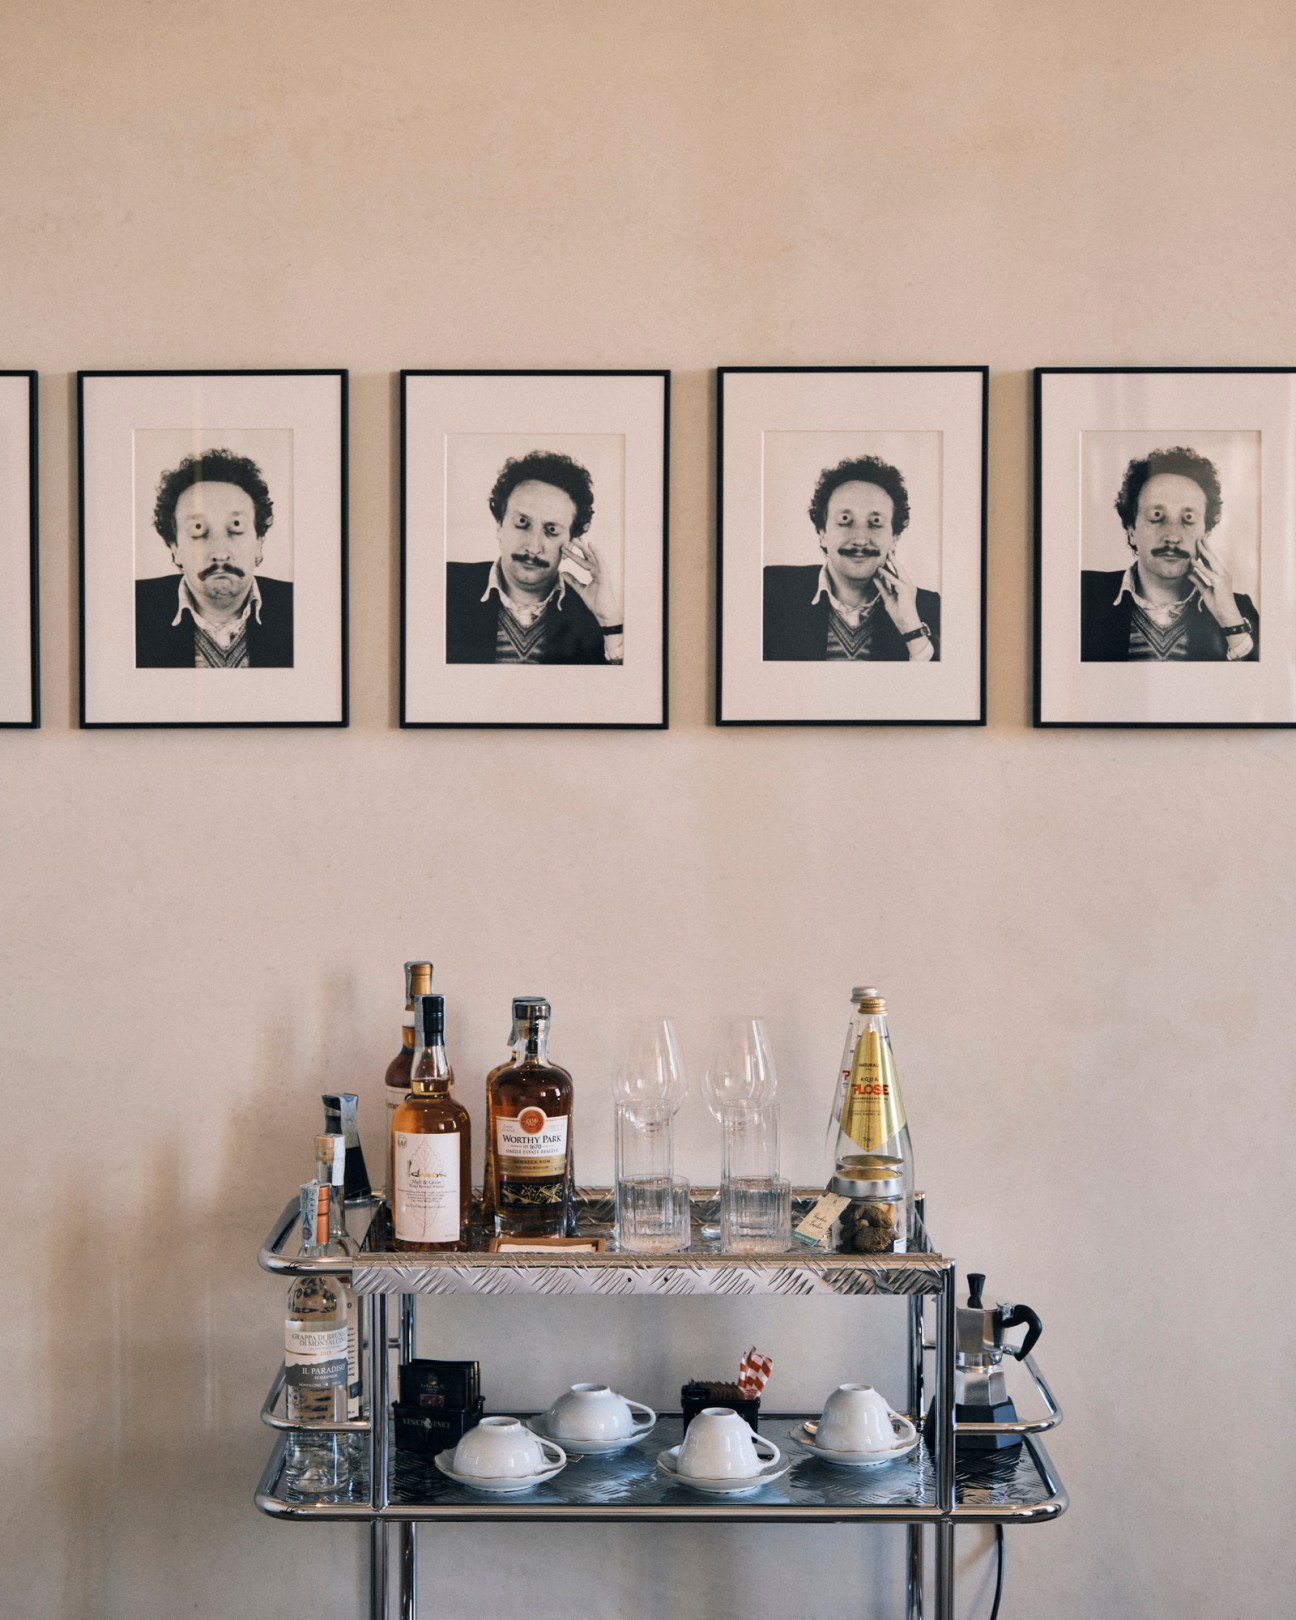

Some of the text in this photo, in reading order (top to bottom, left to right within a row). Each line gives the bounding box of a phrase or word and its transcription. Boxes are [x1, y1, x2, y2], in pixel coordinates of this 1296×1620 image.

[851, 1084, 889, 1095] PLOSE
[502, 1134, 562, 1144] WORTHY PARK
[292, 1333, 317, 1341] GRAPPA
[302, 1367, 310, 1375] IL
